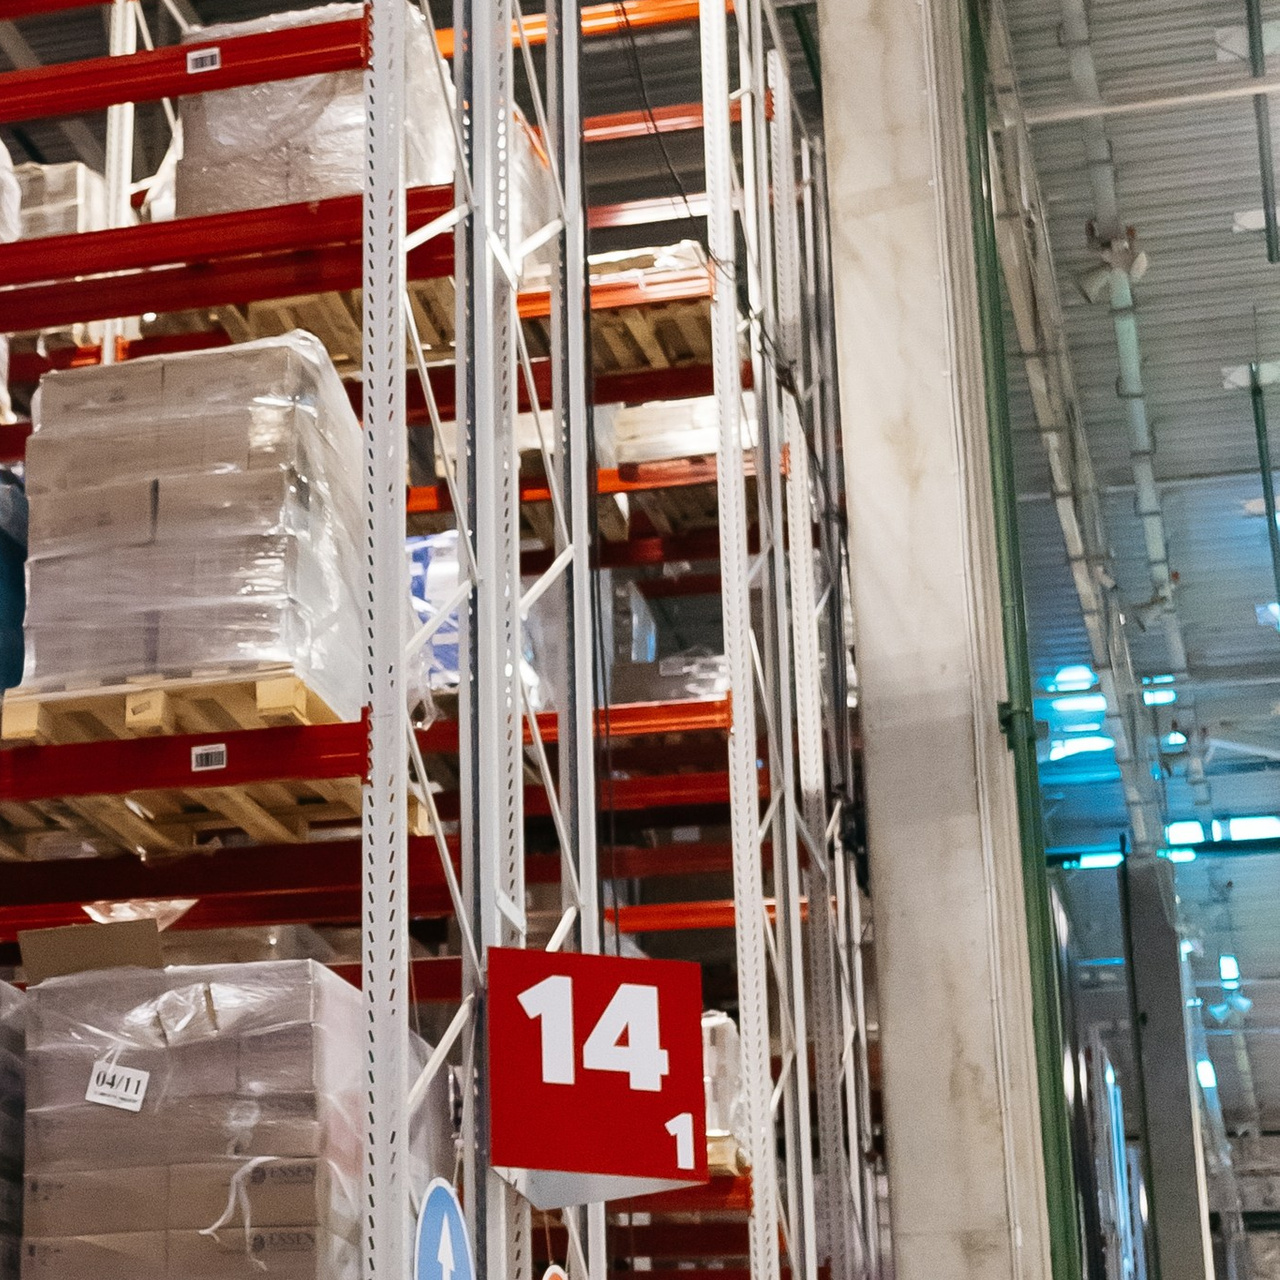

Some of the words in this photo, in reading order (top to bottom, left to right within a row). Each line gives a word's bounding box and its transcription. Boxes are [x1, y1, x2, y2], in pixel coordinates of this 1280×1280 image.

[518, 976, 669, 1091] 14
[95, 1070, 143, 1096] 04/11
[664, 1113, 695, 1170] 1
